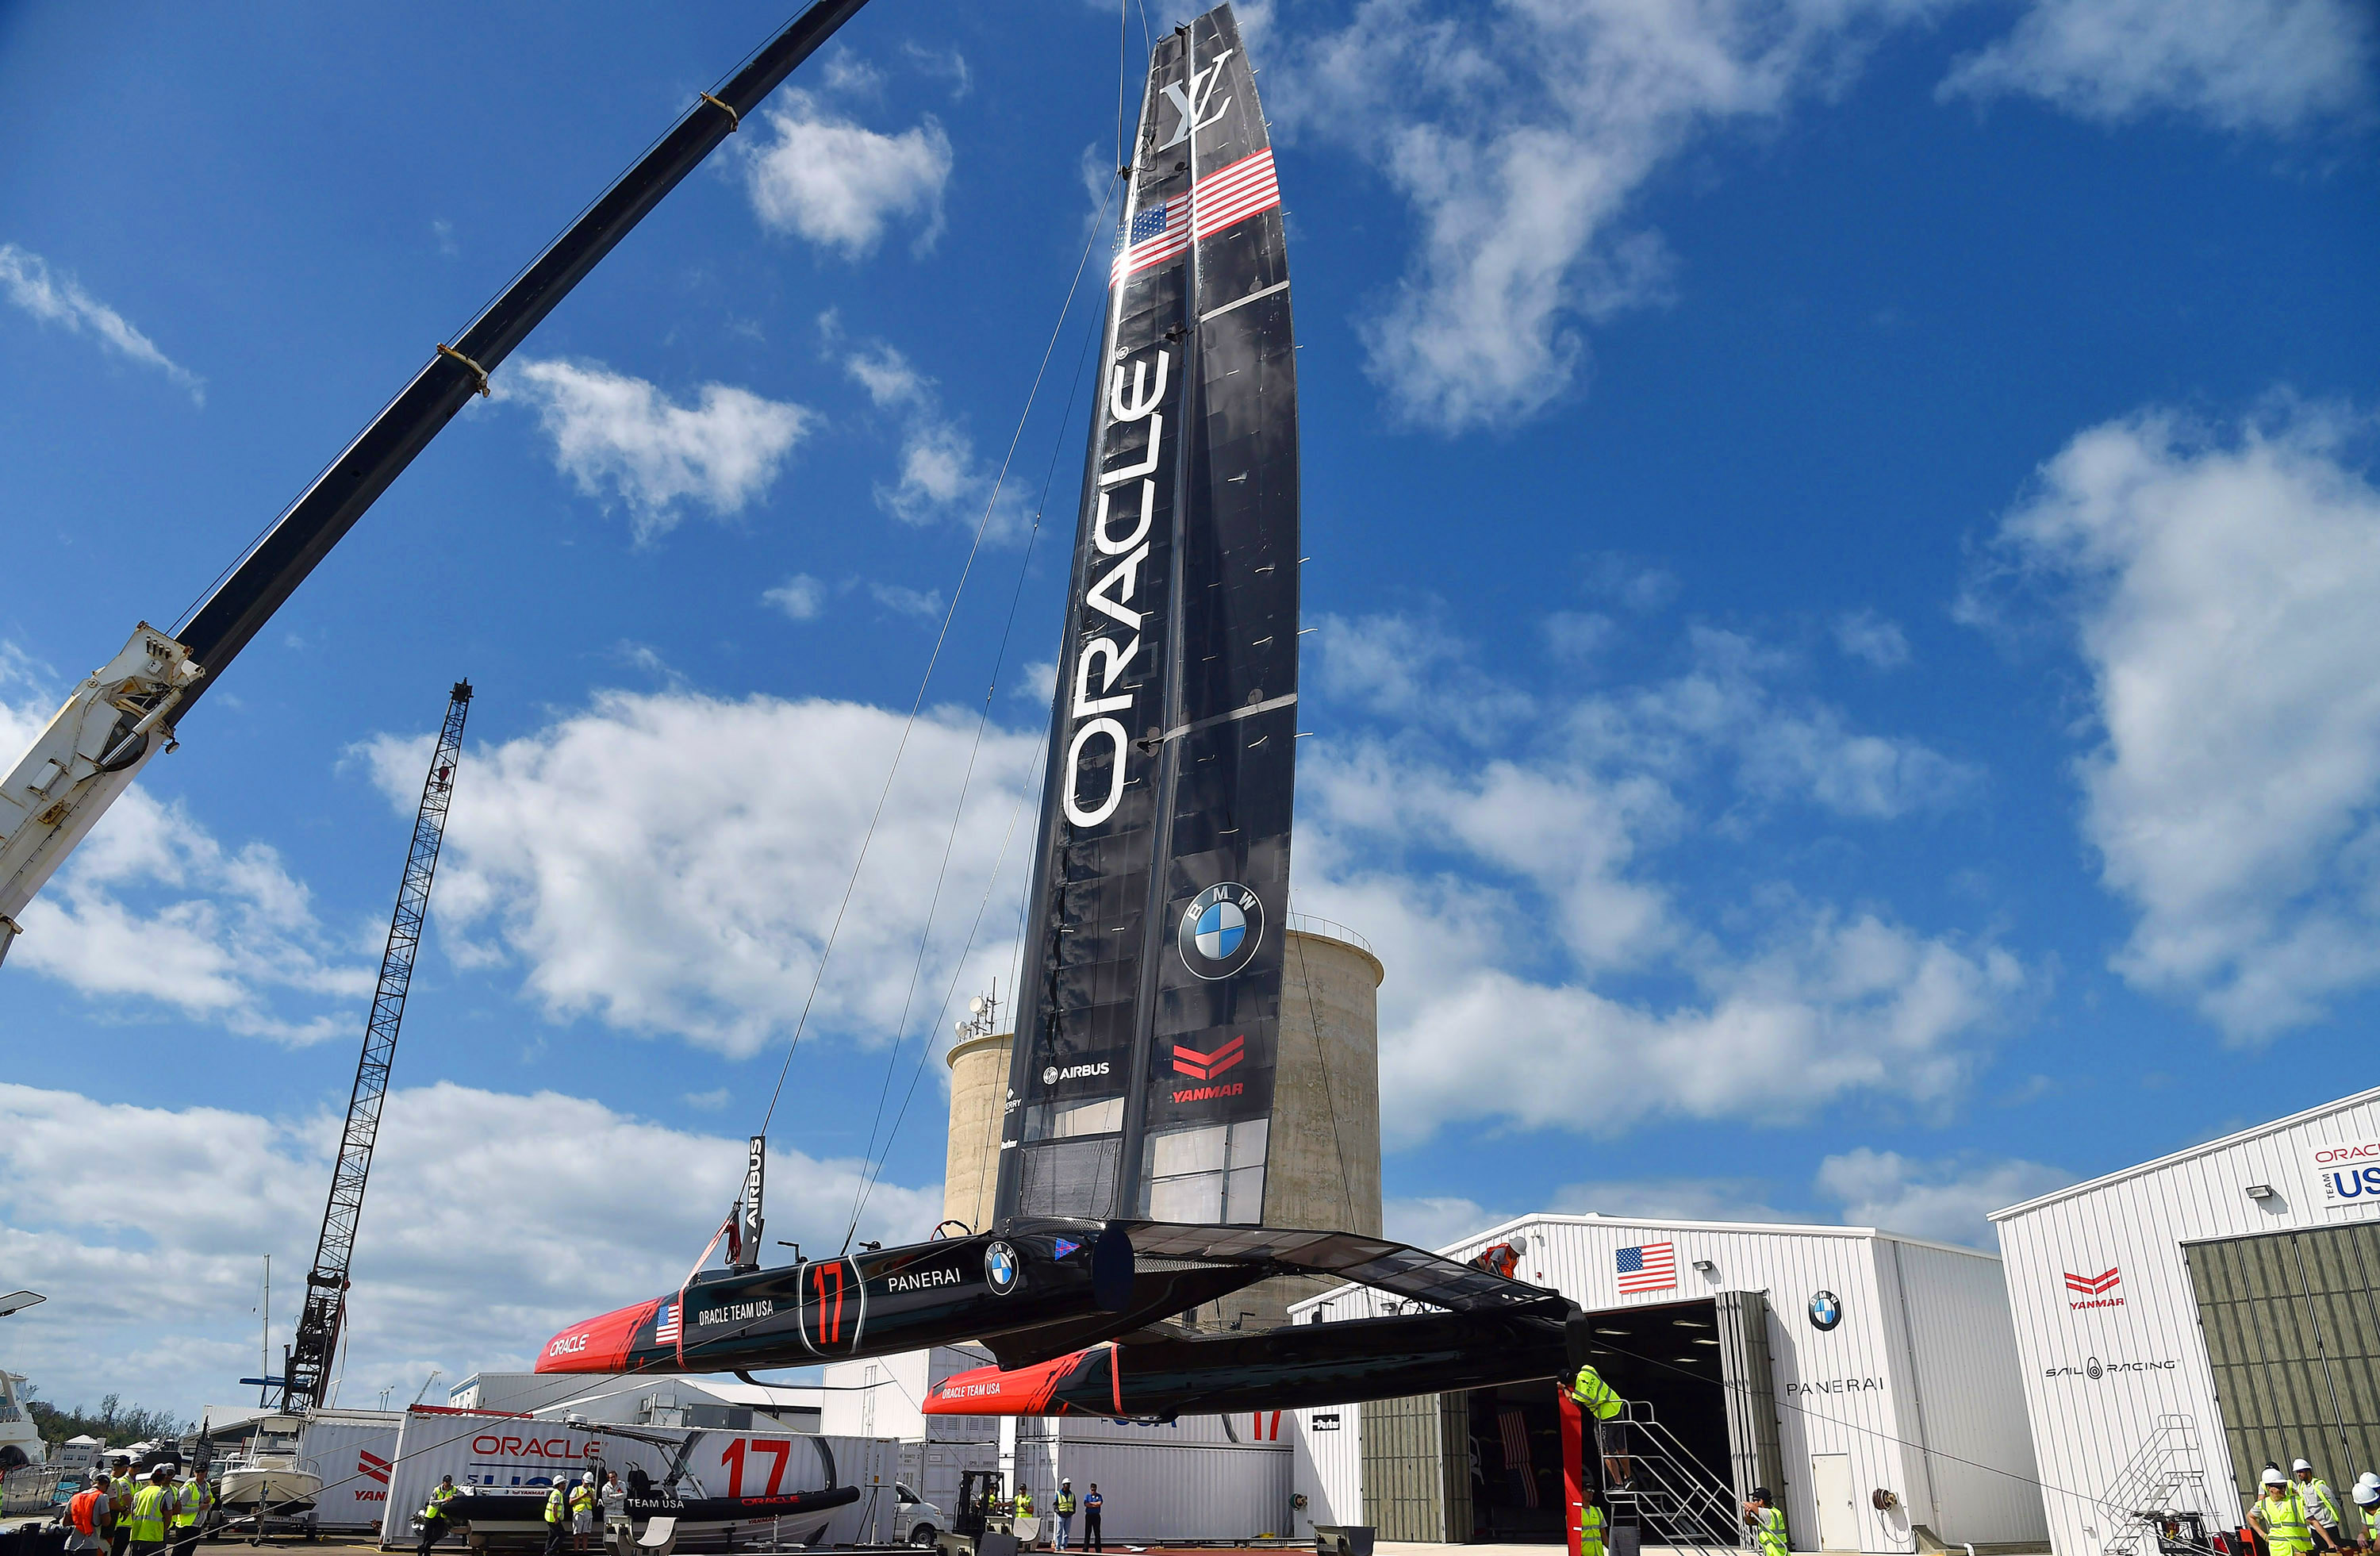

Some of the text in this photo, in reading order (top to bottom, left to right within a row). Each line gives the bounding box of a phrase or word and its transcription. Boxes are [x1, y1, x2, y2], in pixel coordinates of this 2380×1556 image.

[1062, 348, 1170, 828] ORACLE
[1059, 1062, 1110, 1080] AIRBUS
[1173, 1082, 1243, 1104] YANMAR
[1005, 1098, 1022, 1111] ERRY
[2315, 1143, 2380, 1162] ORAC
[747, 1138, 762, 1229] AIRBUS
[2322, 1174, 2335, 1201] TEAM
[888, 1268, 961, 1293] PANERAI
[812, 1262, 843, 1344] 17
[2069, 1297, 2125, 1310] YANMAR
[699, 1300, 774, 1327] ORACLE TEAM USA
[549, 1333, 590, 1357] ORACLE
[2045, 1361, 2175, 1377] SAIL RACING
[942, 1382, 1000, 1400] ORACLE TEAM USA
[1787, 1377, 1883, 1397] PANERAI
[1315, 1418, 1339, 1429] Parker
[472, 1435, 601, 1459] ORACLE
[721, 1438, 791, 1498] 17
[355, 1490, 388, 1501] YAN
[628, 1499, 685, 1509] TEAM USA
[741, 1495, 800, 1506] ORACLE
